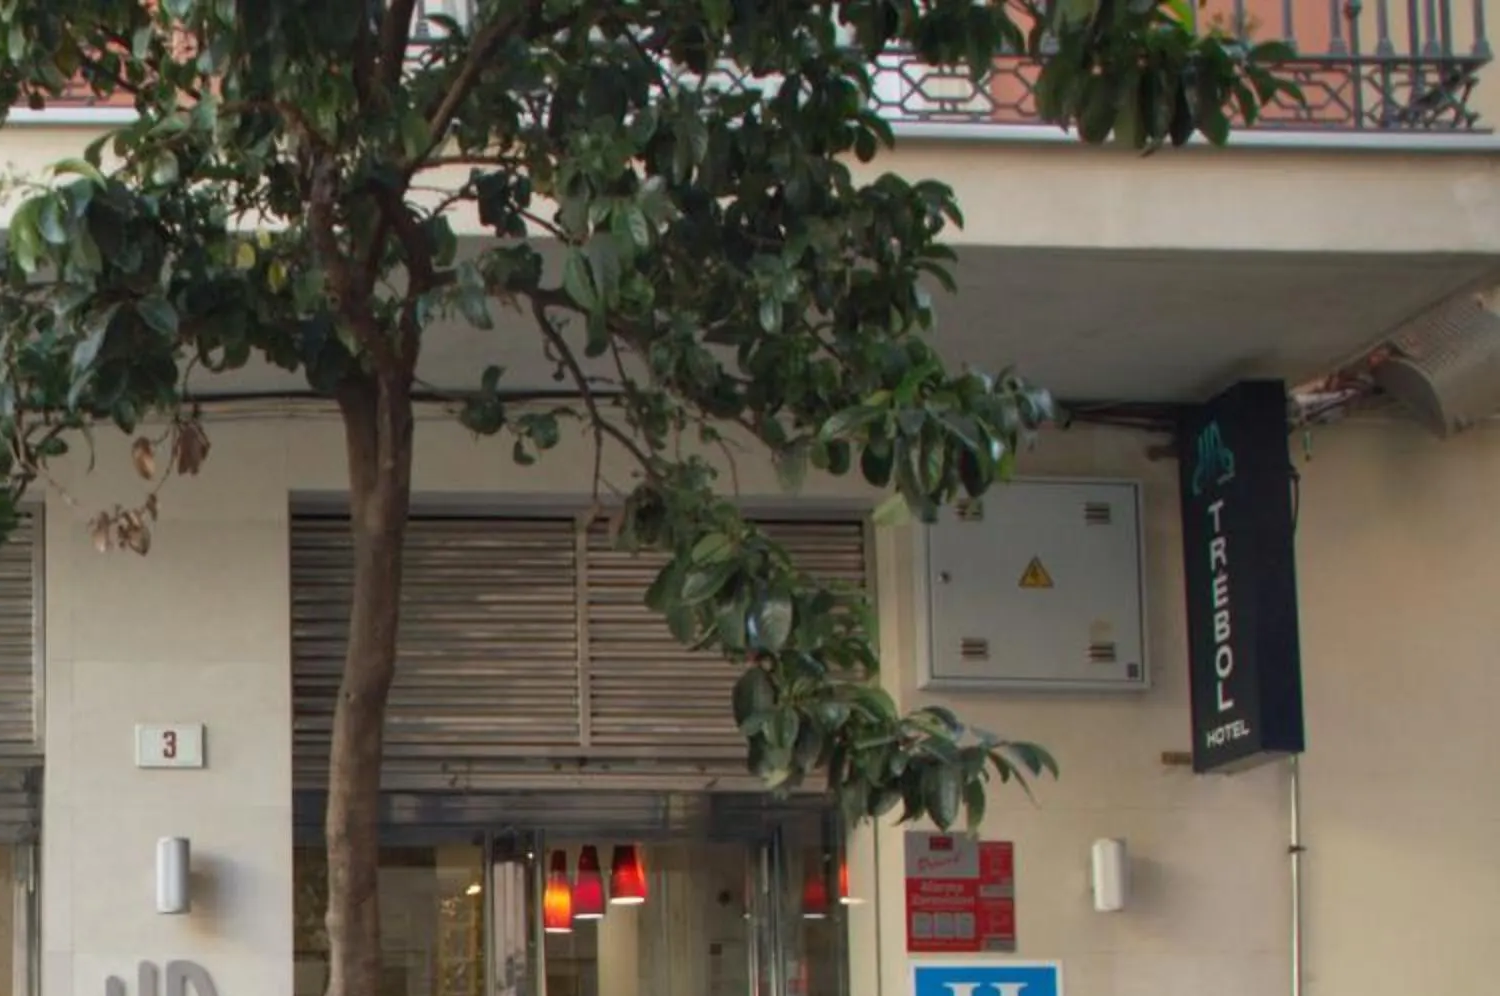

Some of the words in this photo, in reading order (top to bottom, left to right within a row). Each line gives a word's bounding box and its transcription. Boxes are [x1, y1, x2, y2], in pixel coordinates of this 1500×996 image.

[1208, 500, 1235, 711] TREBOL
[162, 731, 177, 759] 3
[1206, 720, 1250, 747] HOTEL
